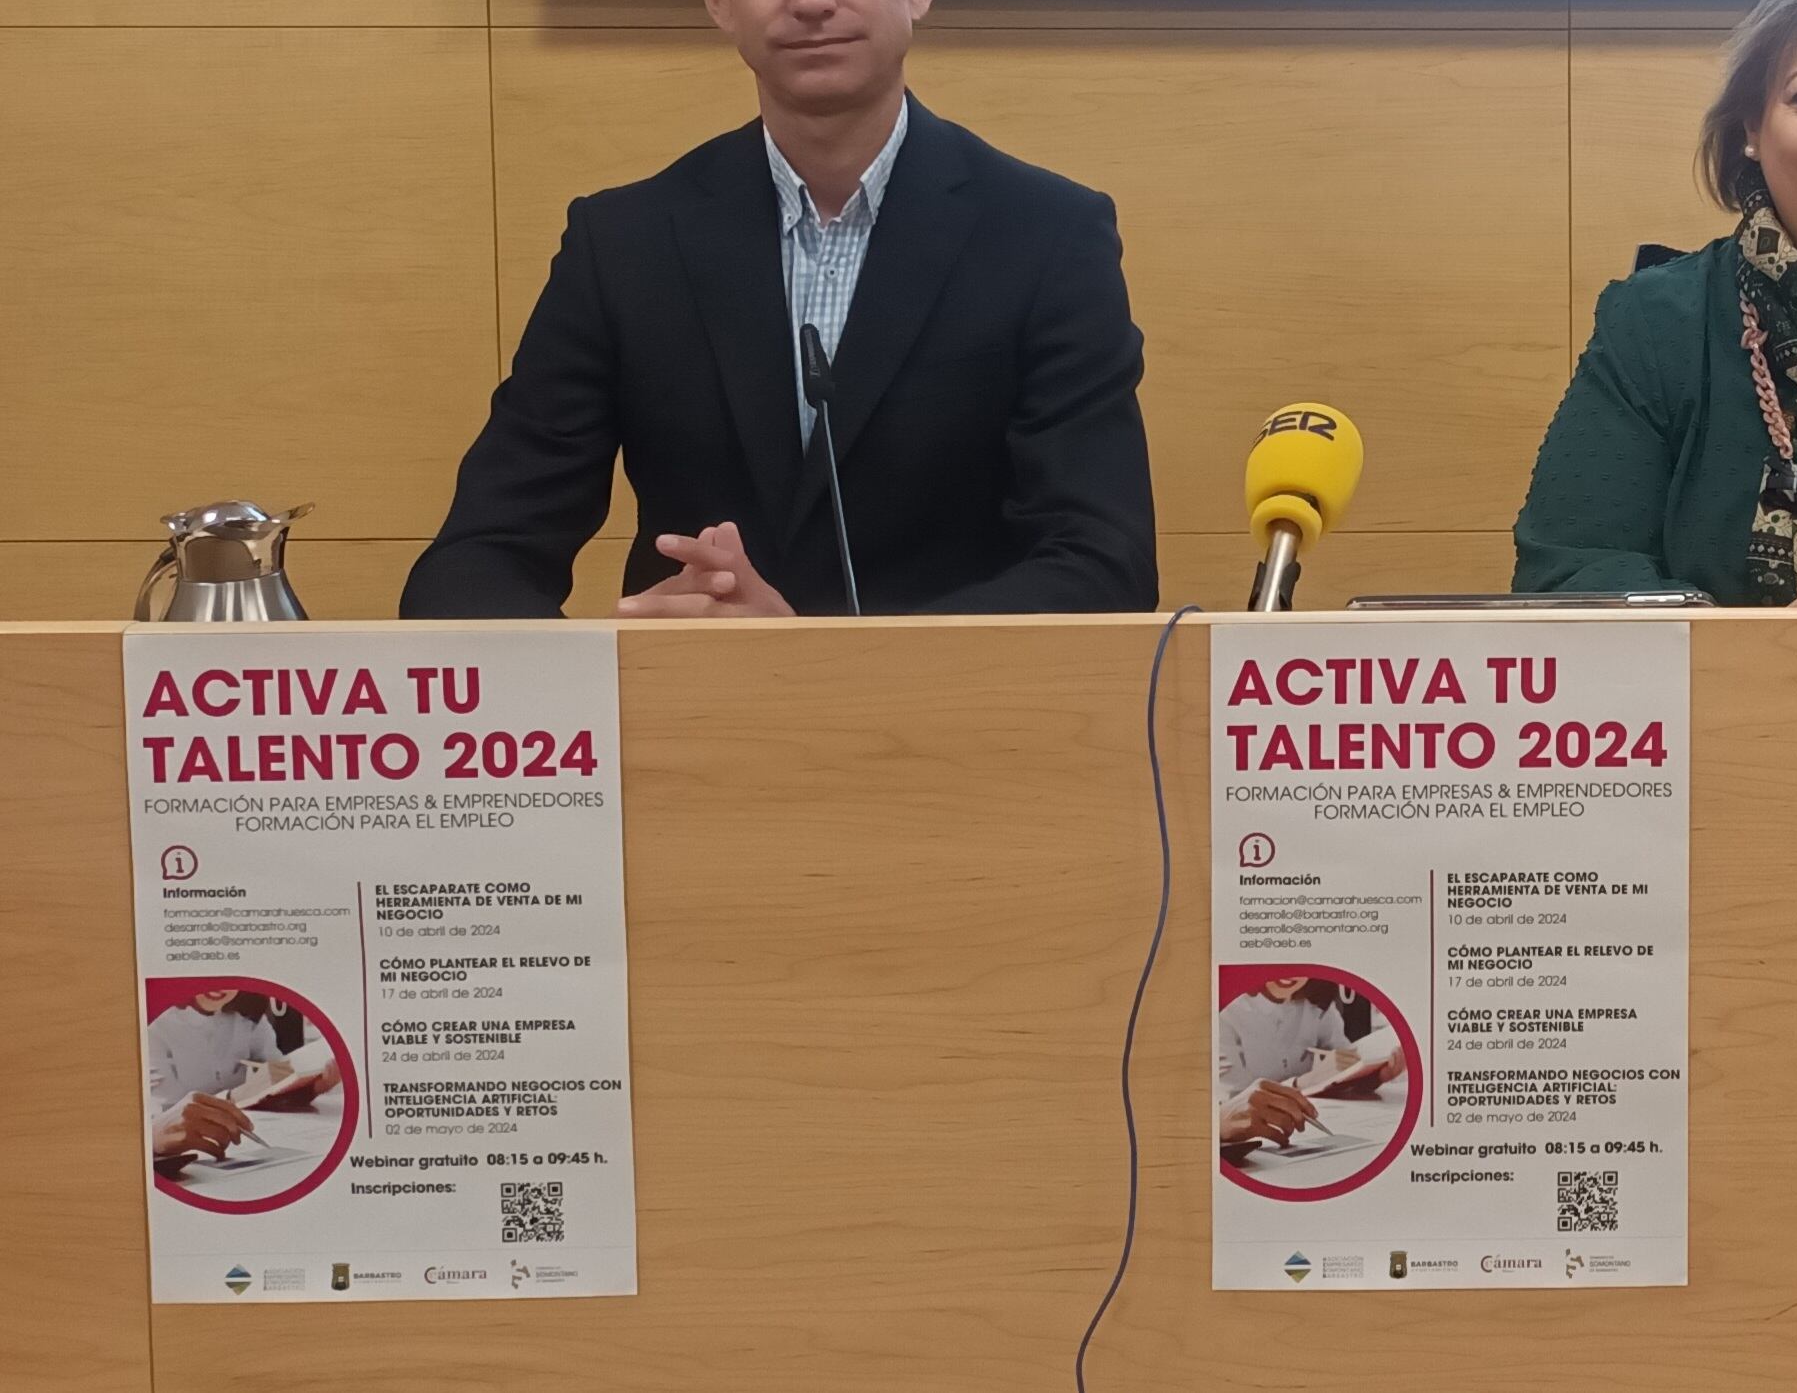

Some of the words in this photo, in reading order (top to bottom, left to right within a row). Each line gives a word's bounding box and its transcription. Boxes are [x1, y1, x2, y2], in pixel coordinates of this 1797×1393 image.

[1227, 657, 1466, 706] ACTIVA
[1486, 657, 1556, 704] TU
[142, 668, 387, 717] ACTIVA
[406, 666, 480, 714] TU
[1226, 721, 1495, 771] TALENTO
[1518, 721, 1667, 768] 2024
[142, 732, 420, 783] TALENTO
[443, 730, 598, 778] 2024
[1226, 782, 1341, 802] FORMACIÓN
[1347, 785, 1397, 800] PARA
[1402, 783, 1492, 801] EMPRESAS
[1497, 783, 1511, 799] &
[1516, 782, 1672, 798] EMPRENDEDORES
[144, 794, 263, 814] FORMACIÓN
[269, 796, 320, 812] PARA
[325, 794, 419, 811] EMPRESAS
[424, 794, 438, 809] &
[443, 791, 604, 809] EMPRENDEDORES
[1314, 801, 1429, 820] FORMACIÓN
[1435, 803, 1484, 818] PARA
[1489, 802, 1508, 818] EL
[1513, 801, 1584, 817] EMPLEO
[235, 812, 354, 832] FORMACIÓN
[360, 814, 411, 829] PARA
[416, 813, 435, 829] EL
[439, 812, 514, 828] EMPLEO
[1239, 873, 1321, 885] Información
[1447, 873, 1460, 884] EL
[1464, 872, 1549, 883] ESCAPARATE
[1553, 871, 1598, 882] COMO
[163, 885, 246, 898] Información
[1447, 884, 1540, 896] HERRAMIENTA
[1544, 884, 1560, 895] DE
[1564, 884, 1607, 895] VENTA
[1611, 884, 1627, 895] DE
[1632, 883, 1648, 894] MI
[1239, 894, 1422, 905] formacion@camarahuesca.com
[1447, 897, 1512, 908] NEGOCIO
[1239, 909, 1379, 921] desarrollo@barbastro.org
[1448, 914, 1462, 925] 10
[1465, 914, 1483, 925] de
[1486, 913, 1513, 925] abril
[1516, 913, 1534, 924] de
[1537, 913, 1566, 924] 2024
[1239, 923, 1389, 935] desarrollo@somontano.org
[1239, 937, 1312, 948] aeb@aeb.es
[1447, 944, 1492, 958] CÓMO
[1496, 945, 1562, 957] PLANTEAR
[1566, 945, 1580, 956] EL
[1584, 945, 1633, 956] RELEVO
[1637, 945, 1653, 956] DE
[1447, 959, 1463, 970] MI
[1467, 958, 1532, 970] NEGOCIO
[1449, 976, 1462, 987] 17
[1465, 976, 1483, 988] de
[1486, 976, 1513, 987] abril
[1516, 975, 1534, 987] de
[1537, 975, 1566, 987] 2024
[1447, 1007, 1492, 1020] CÓMO
[1496, 1009, 1540, 1020] CREAR
[1545, 1008, 1573, 1019] UNA
[1578, 1008, 1637, 1019] EMPRESA
[1447, 1022, 1492, 1033] VIABLE
[1497, 1022, 1504, 1032] Y
[1509, 1021, 1583, 1032] SOSTENIBLE
[1447, 1039, 1462, 1050] 24
[1465, 1039, 1483, 1050] de
[1486, 1038, 1513, 1050] abril
[1516, 1038, 1534, 1049] de
[1538, 1037, 1566, 1049] 2024
[1447, 1069, 1568, 1081] TRANSFORMANDO
[1572, 1069, 1644, 1080] NEGOCIOS
[1648, 1069, 1680, 1080] CON
[1447, 1082, 1538, 1094] INTELIGENCIA
[1542, 1081, 1617, 1092] ARTIFICIAL:
[1447, 1094, 1559, 1106] OPORTUNIDADES
[1563, 1094, 1571, 1104] Y
[1576, 1094, 1616, 1105] RETOS
[1446, 1112, 1462, 1124] 02
[1465, 1112, 1483, 1123] de
[1486, 1113, 1523, 1124] mayo
[1526, 1111, 1544, 1122] de
[1547, 1110, 1576, 1122] 2024
[1410, 1143, 1474, 1156] Webinar
[1477, 1142, 1536, 1158] gratuito
[1545, 1141, 1586, 1154] 08:15
[1589, 1144, 1600, 1154] a
[1604, 1141, 1645, 1153] 09:45
[1649, 1140, 1663, 1153] h.
[349, 1155, 414, 1168] Webinar
[418, 1154, 478, 1170] gratuito
[486, 1153, 528, 1166] 08:15
[532, 1155, 543, 1165] a
[547, 1151, 590, 1164] 09:45
[594, 1151, 608, 1164] h.
[1410, 1169, 1514, 1184] Inscripciones:
[351, 1181, 456, 1196] Inscripciones:
[1480, 1255, 1542, 1270] Cámara
